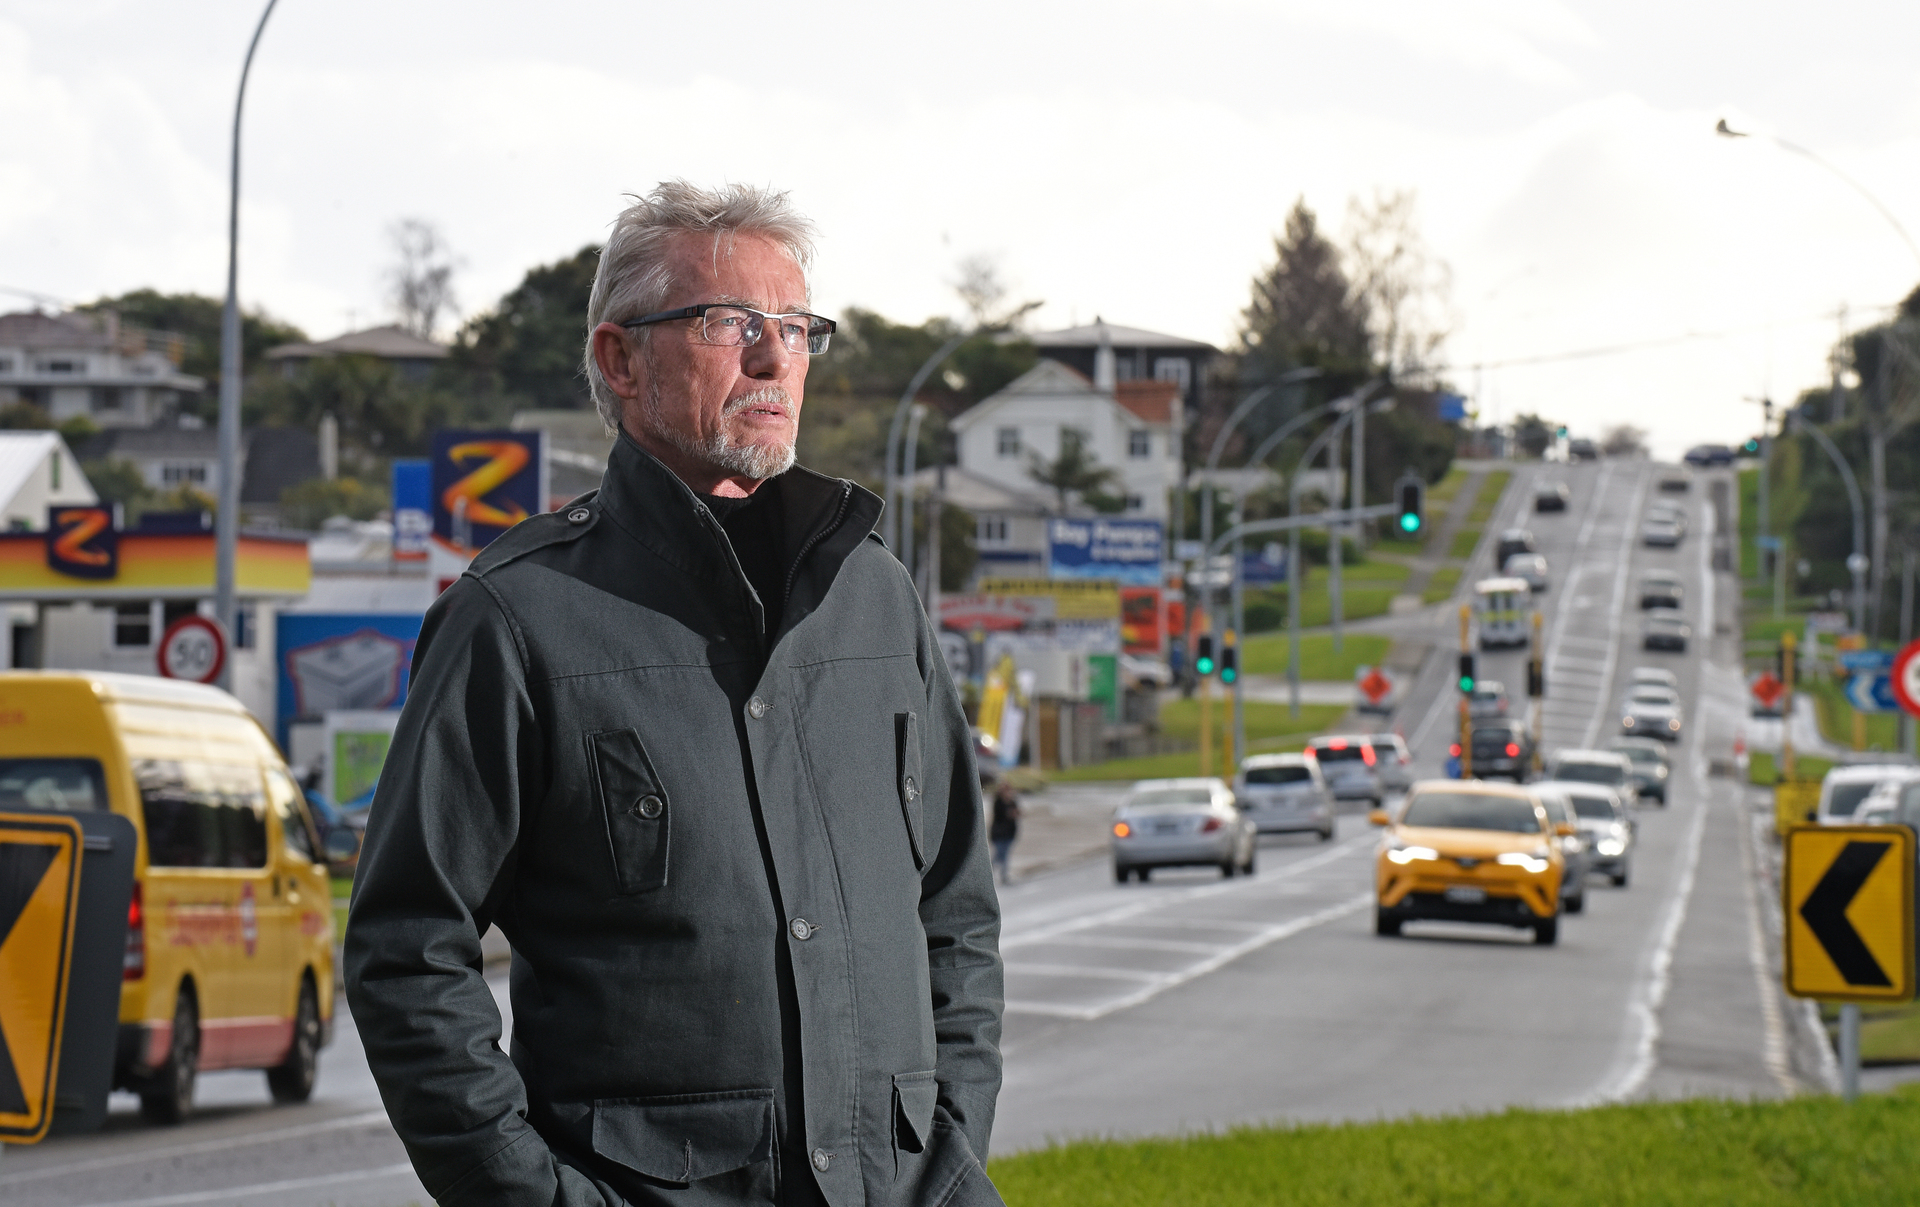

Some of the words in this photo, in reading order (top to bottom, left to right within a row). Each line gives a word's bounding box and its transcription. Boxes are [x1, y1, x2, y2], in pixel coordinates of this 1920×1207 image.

[442, 439, 530, 528] Z
[54, 508, 110, 566] Z
[174, 638, 213, 670] 50
